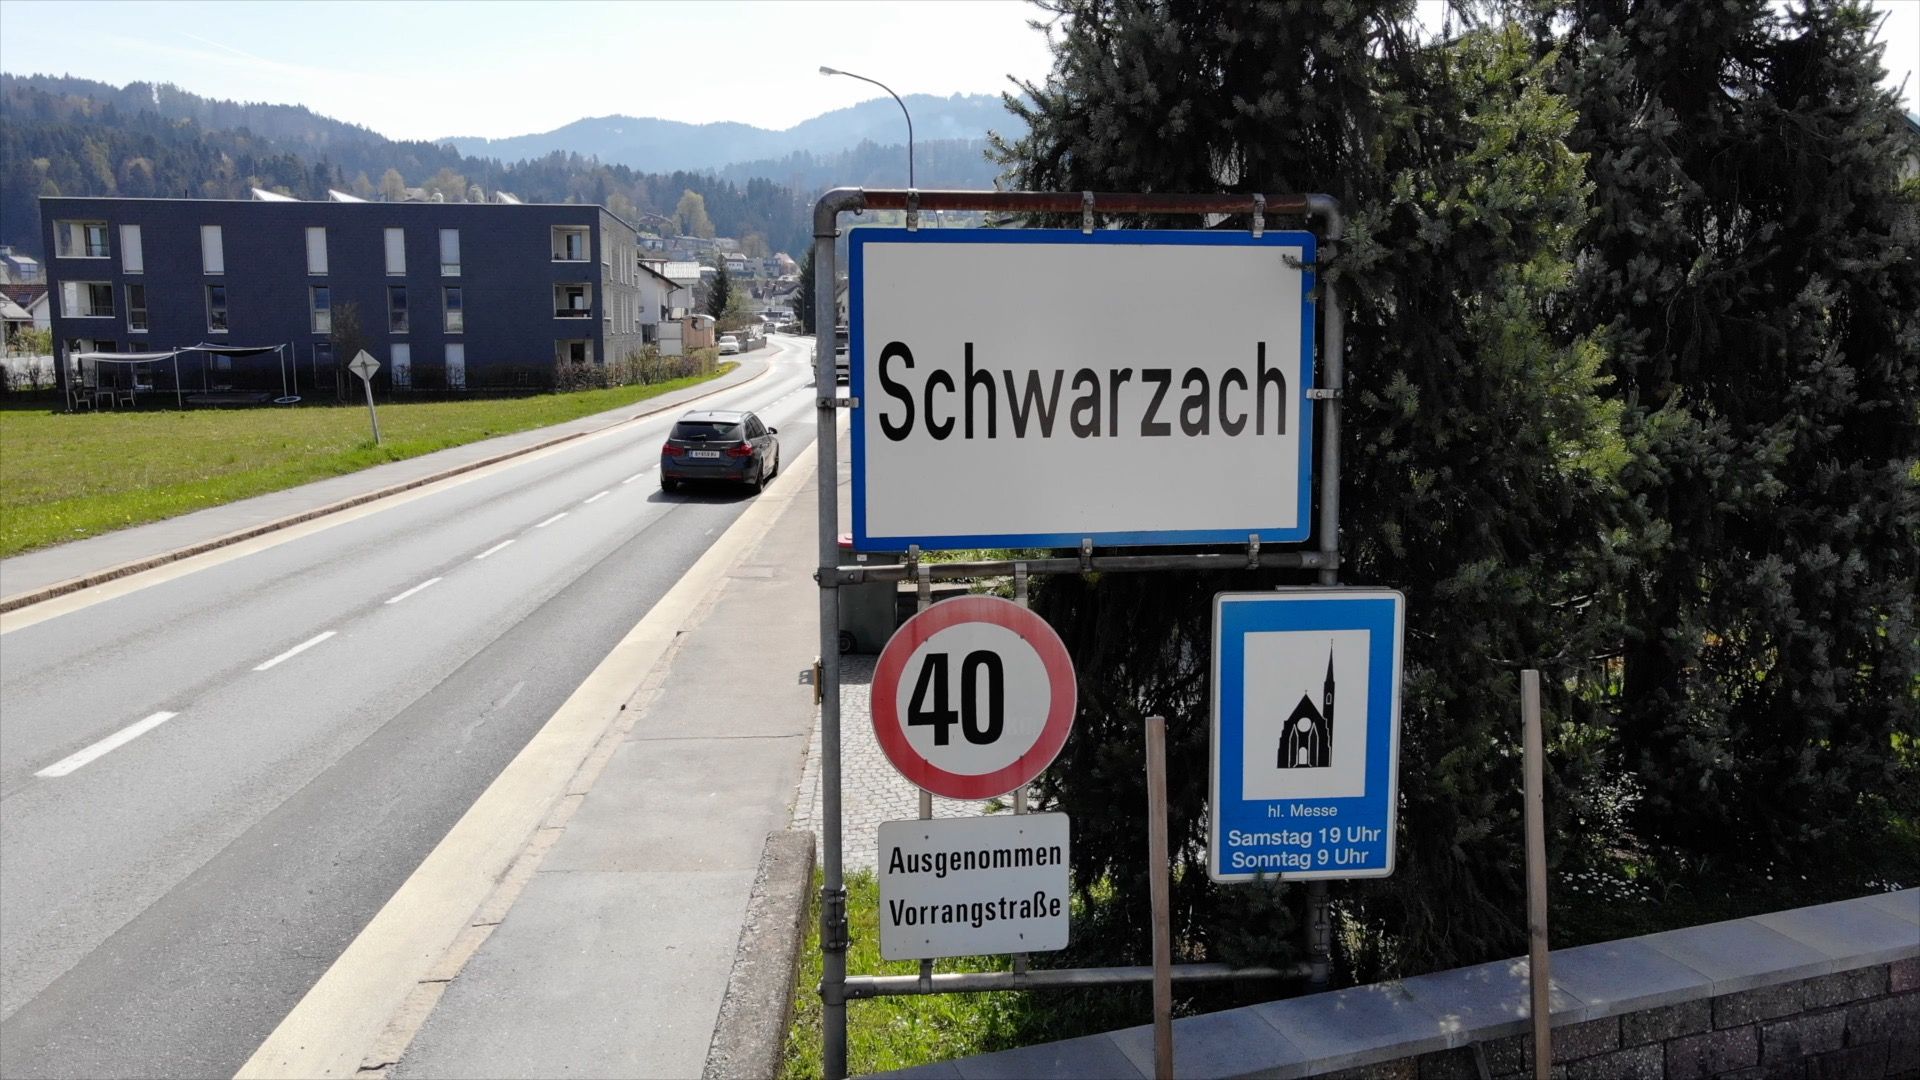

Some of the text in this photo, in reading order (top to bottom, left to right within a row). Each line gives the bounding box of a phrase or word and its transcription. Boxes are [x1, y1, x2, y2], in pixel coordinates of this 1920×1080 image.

[879, 341, 1286, 441] Schwarzach
[907, 649, 1004, 746] 40
[1268, 804, 1338, 818] hl. Messe
[1228, 826, 1381, 848] Samstag 19 Uhr
[888, 845, 1061, 879] Ausgenommen
[1232, 848, 1369, 870] Sonntag 9 Uhr
[888, 890, 1061, 929] Vorrangstraße
